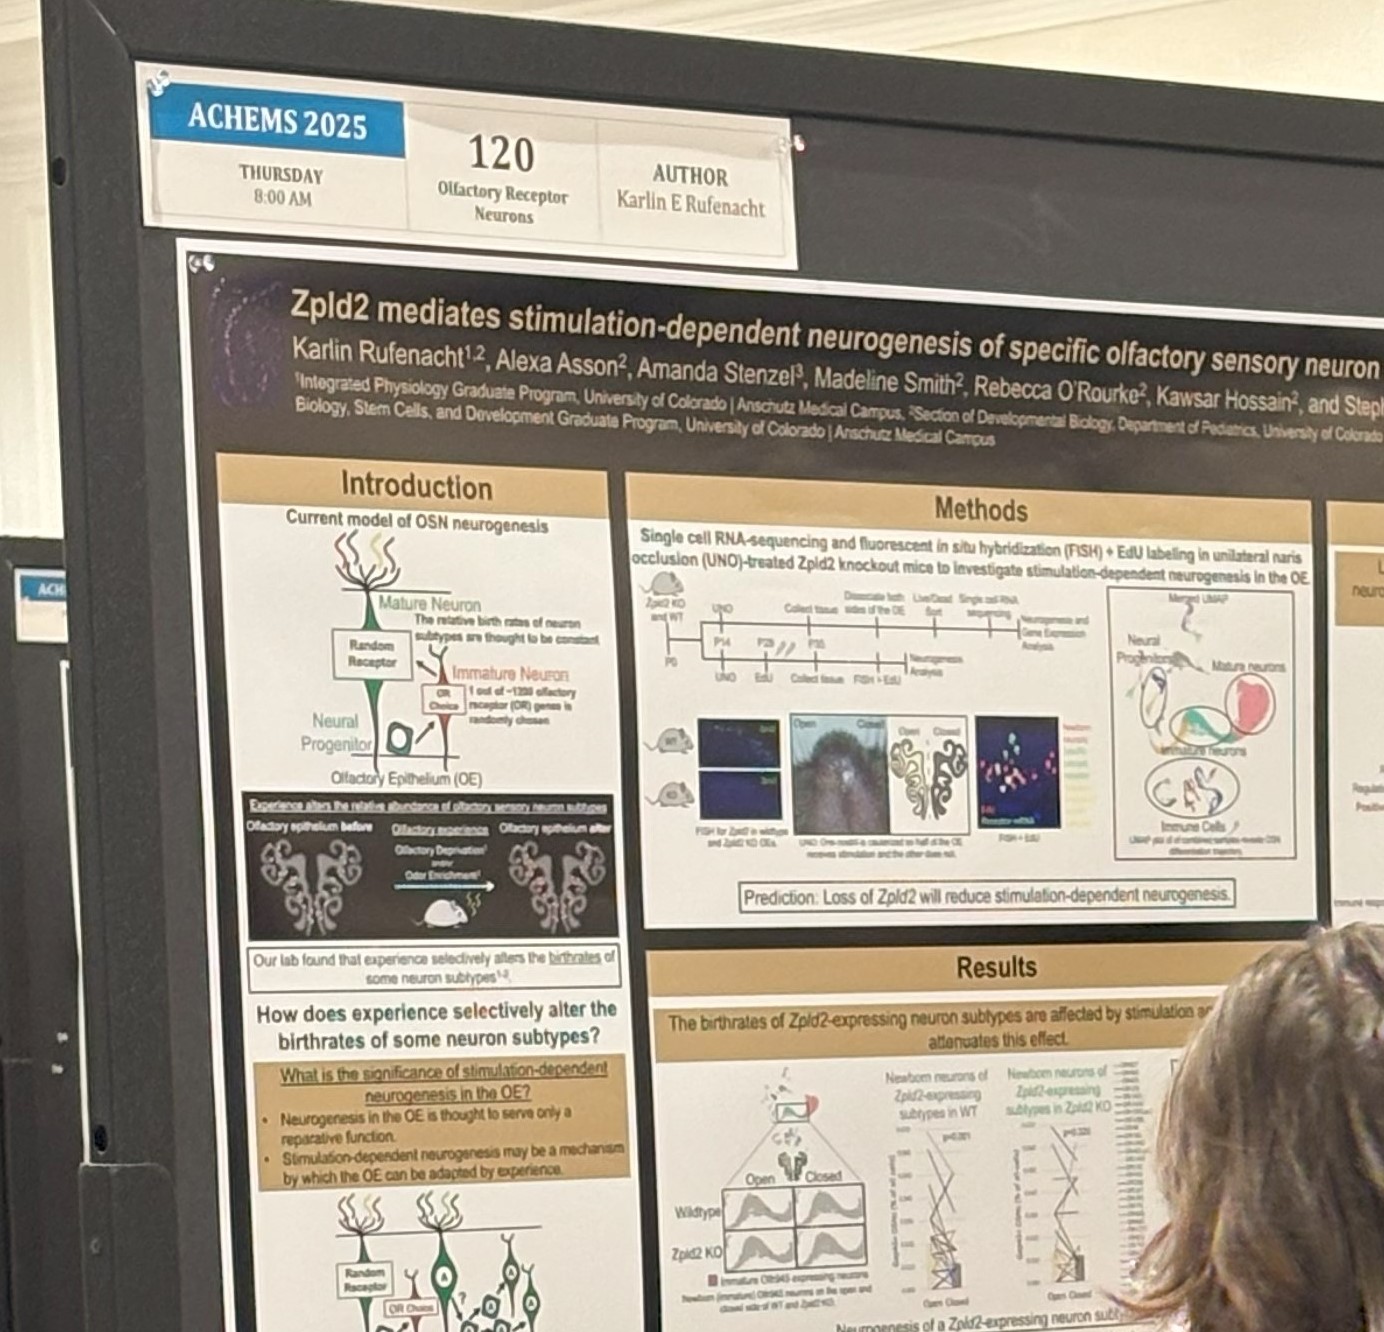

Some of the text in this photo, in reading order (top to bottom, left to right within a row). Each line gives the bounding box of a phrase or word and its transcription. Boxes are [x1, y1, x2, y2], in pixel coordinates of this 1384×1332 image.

[187, 101, 368, 141] ACHEMS 2025
[469, 133, 534, 173] 120
[238, 163, 324, 185] THURSDAY
[652, 163, 729, 188] AUTHOR
[253, 188, 312, 208] 8:00 AM
[437, 180, 569, 207] Olfactory Receptor
[617, 188, 766, 218] Karlin E Rufenacht
[474, 205, 535, 225] Neurons
[290, 288, 369, 326] Zpld2
[377, 297, 501, 329] mediates
[508, 305, 802, 348] stimulation-dependent
[807, 328, 973, 360] neurogenesis
[979, 332, 1006, 359] of
[1008, 337, 1101, 367] specific
[1105, 339, 1207, 377] olfactory
[1211, 351, 1301, 382] sensory
[1304, 357, 1381, 380] neuron
[292, 335, 353, 362] Karlin
[495, 347, 553, 374] Alexa
[636, 356, 718, 383] Amanda
[814, 365, 899, 393] Madeline
[974, 374, 1053, 401] Rebecca
[1157, 384, 1220, 409] Kawsar
[1308, 393, 1339, 415] and
[342, 468, 493, 501] Introduction
[935, 494, 1029, 523] Methods
[286, 507, 549, 536] Current model of OSN neurogenesis
[378, 594, 482, 613] Mature Neuron
[452, 664, 569, 683] Immature Neuron
[312, 712, 359, 729] Neural
[301, 736, 372, 754] Progenitor
[330, 769, 483, 789] Olfactory Epithelium (OE)
[823, 889, 857, 906] Loss
[859, 888, 874, 906] of
[919, 888, 942, 904] will
[944, 887, 992, 905] reduce
[994, 886, 1140, 906] stimulation-dependent
[957, 954, 1038, 979] Results
[257, 1000, 617, 1025] How does experience selectively alter the
[278, 1025, 600, 1051] birthrates of some neuron subtypes?
[280, 1061, 609, 1084] What is the significance of stimulation-dependent
[365, 1084, 531, 1103] neurogenesis in the OE?
[745, 1169, 843, 1188] Open Closed
[675, 1205, 722, 1223] Wildtype
[671, 1246, 723, 1264] Zpld2 KO
